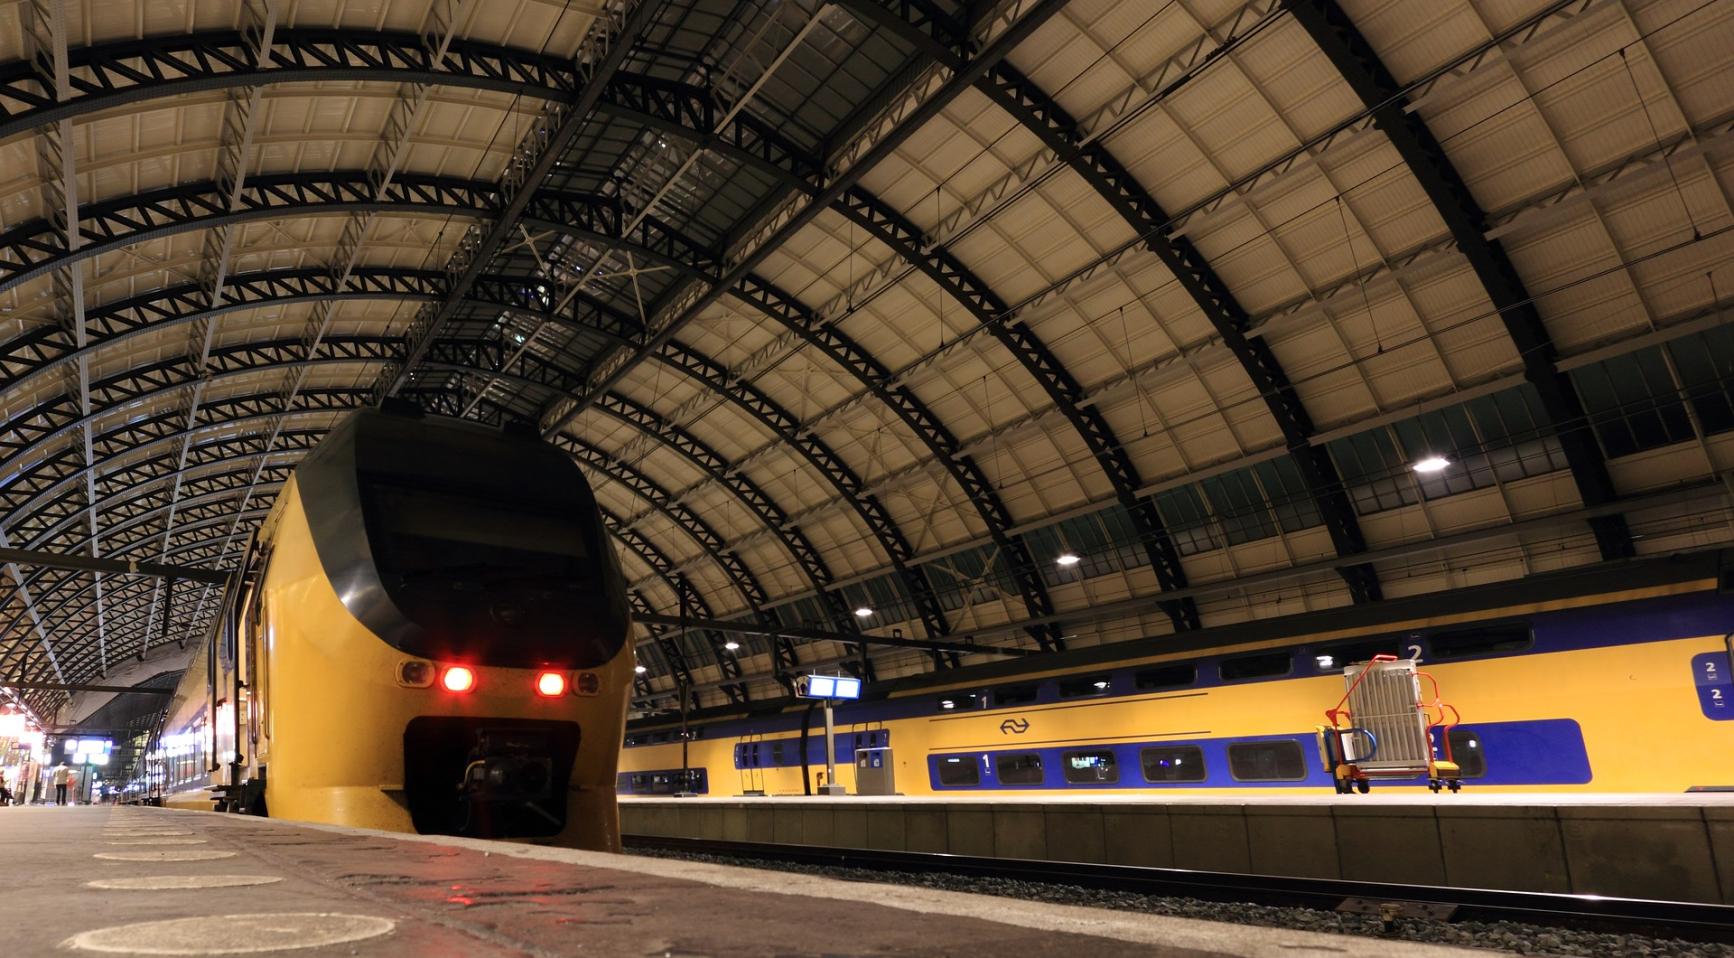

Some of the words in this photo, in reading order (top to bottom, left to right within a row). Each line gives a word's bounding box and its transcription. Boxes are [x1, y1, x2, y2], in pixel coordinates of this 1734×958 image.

[1408, 645, 1423, 663] 2
[1705, 662, 1716, 672] 2
[1711, 689, 1722, 699] 2
[981, 696, 987, 709] 1
[982, 754, 989, 768] 1
